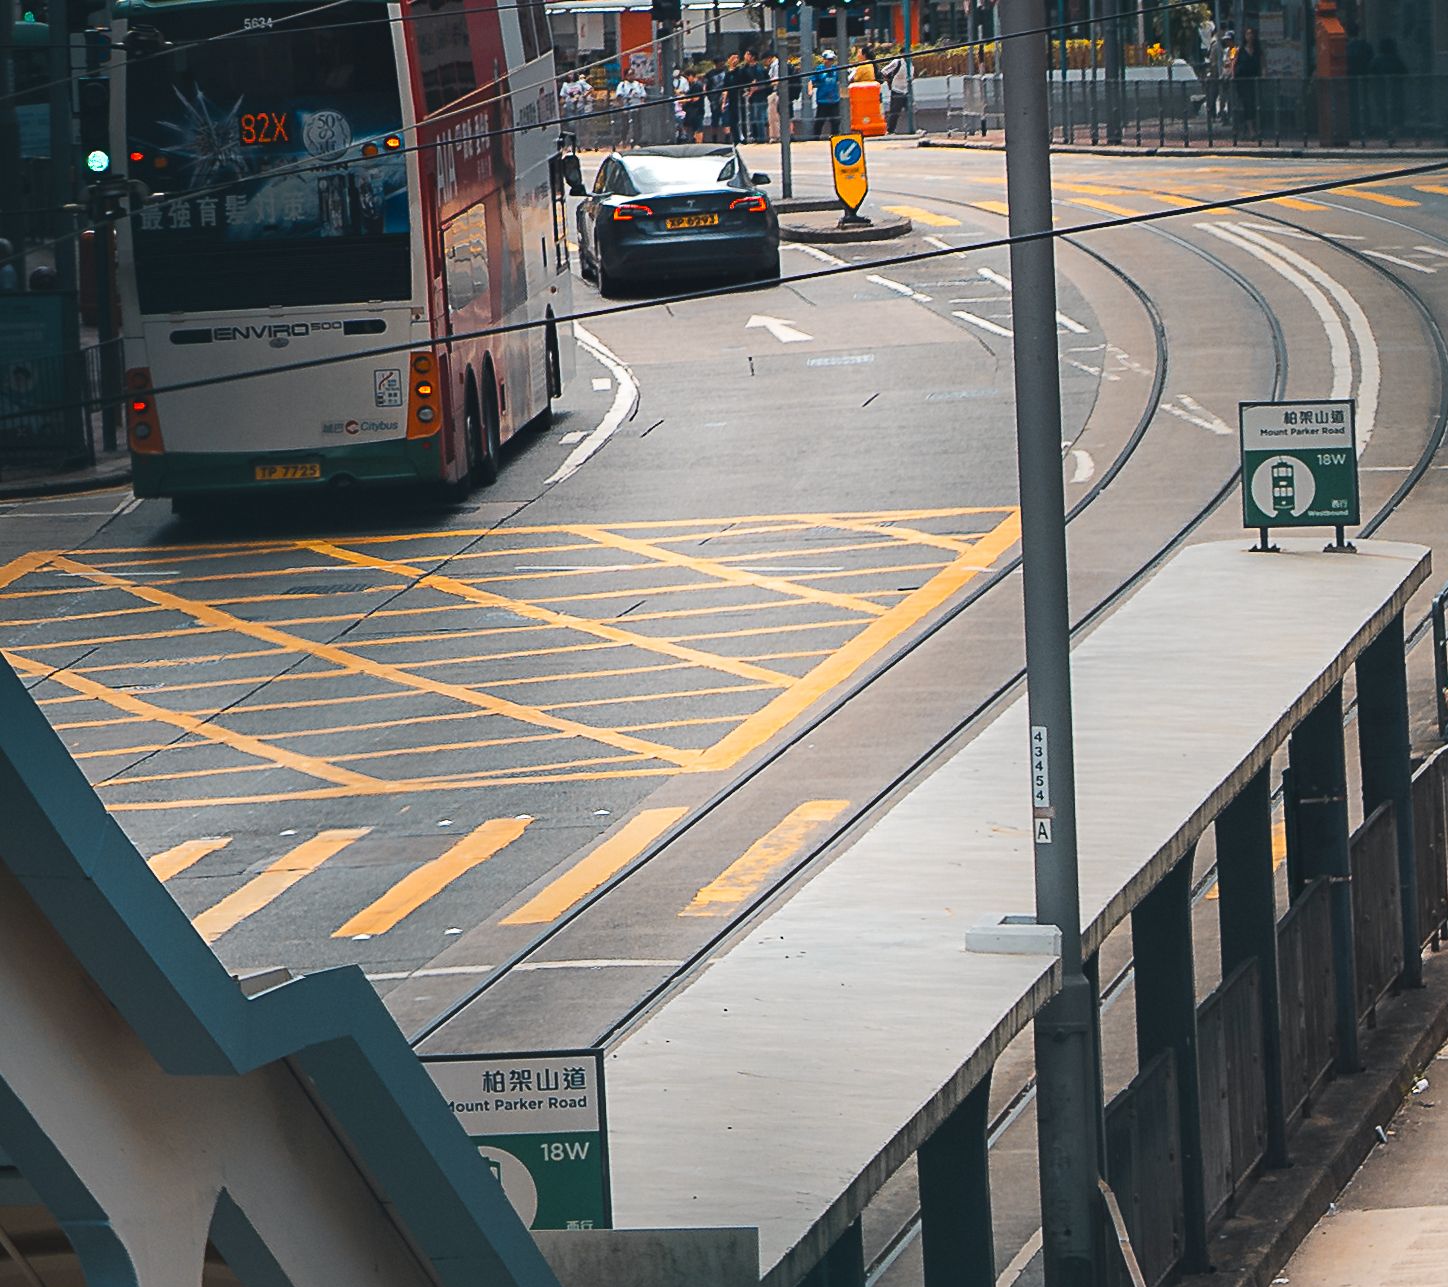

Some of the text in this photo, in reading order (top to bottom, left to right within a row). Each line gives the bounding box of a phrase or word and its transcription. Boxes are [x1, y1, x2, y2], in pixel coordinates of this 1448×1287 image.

[242, 113, 288, 143] 82X
[1284, 410, 1345, 425] 柏架山道
[361, 420, 398, 433] Citybus
[1260, 426, 1345, 436] Mount Parker Road
[1317, 454, 1346, 466] 18W
[482, 1067, 586, 1093] 柏架山道
[494, 1098, 543, 1111] Parker
[549, 1096, 587, 1109] Road
[540, 1142, 590, 1161] 18W
